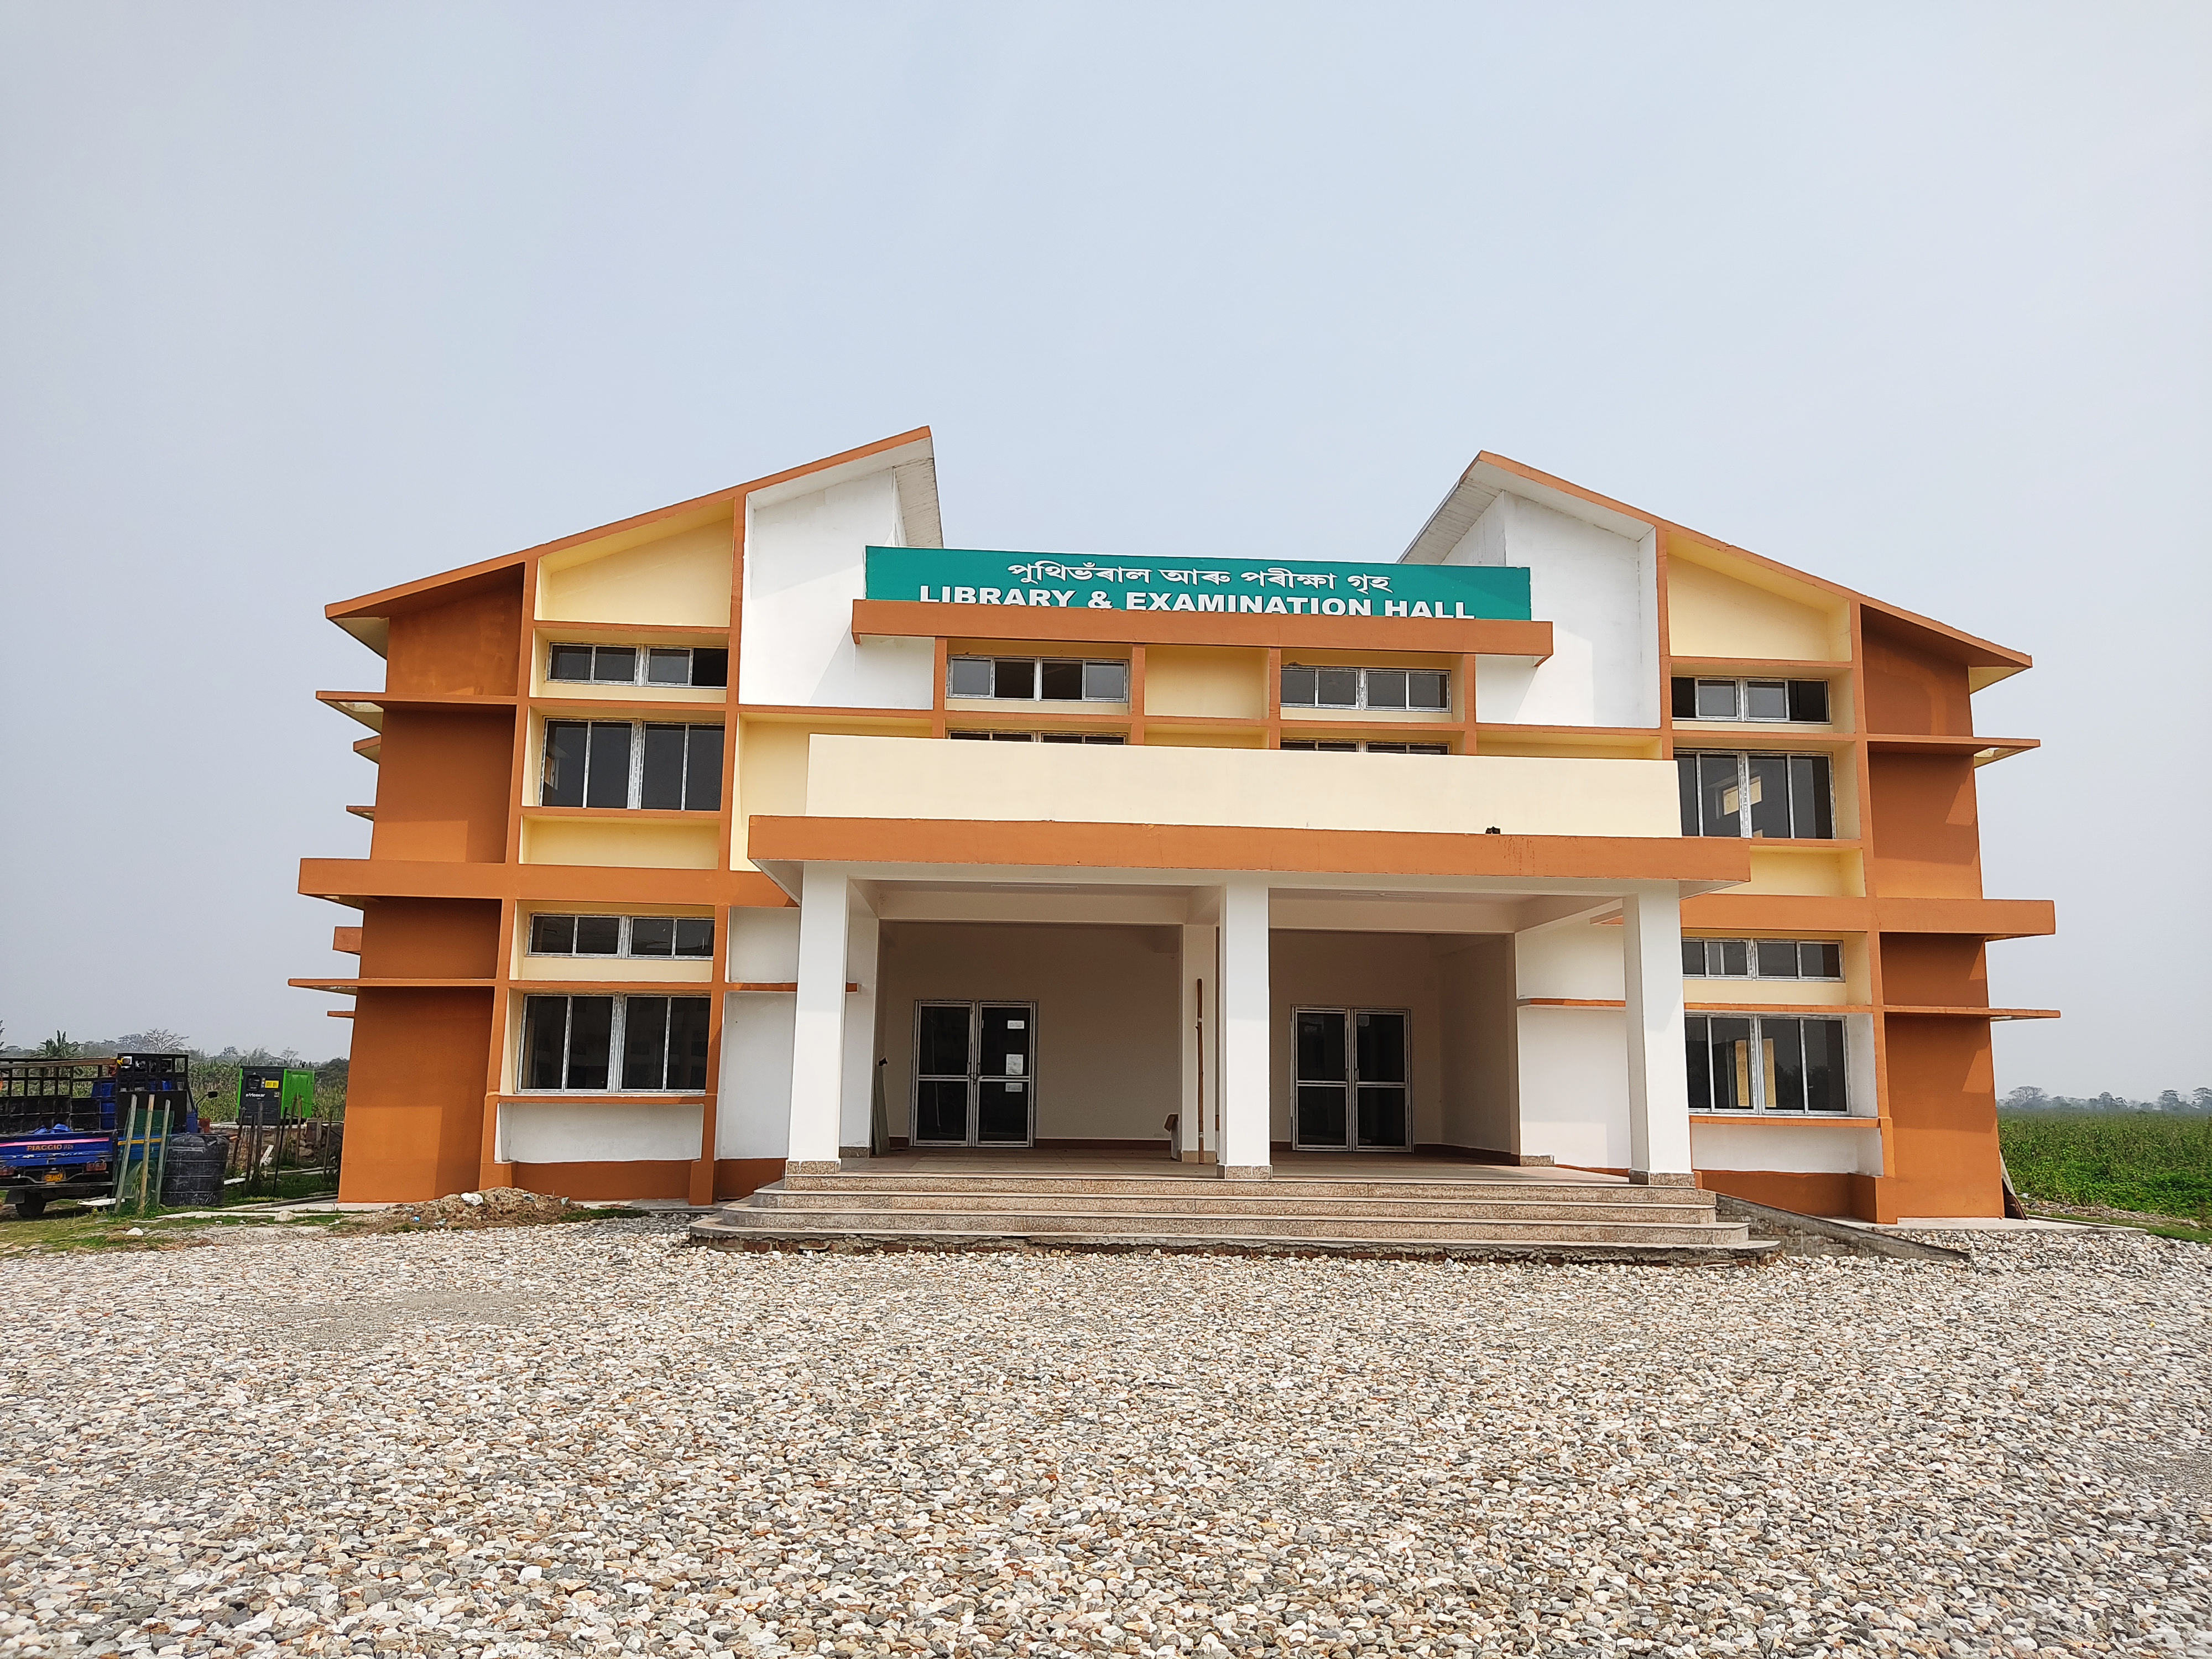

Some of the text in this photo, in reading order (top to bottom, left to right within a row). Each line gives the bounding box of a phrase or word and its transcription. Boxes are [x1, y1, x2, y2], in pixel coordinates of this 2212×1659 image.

[1158, 568, 1231, 586] আৰু
[1240, 567, 1338, 590] পৰীক্ষা
[1347, 573, 1394, 595] গৃহ
[920, 585, 1475, 620] LIBRARY & EXAMINATION HALL
